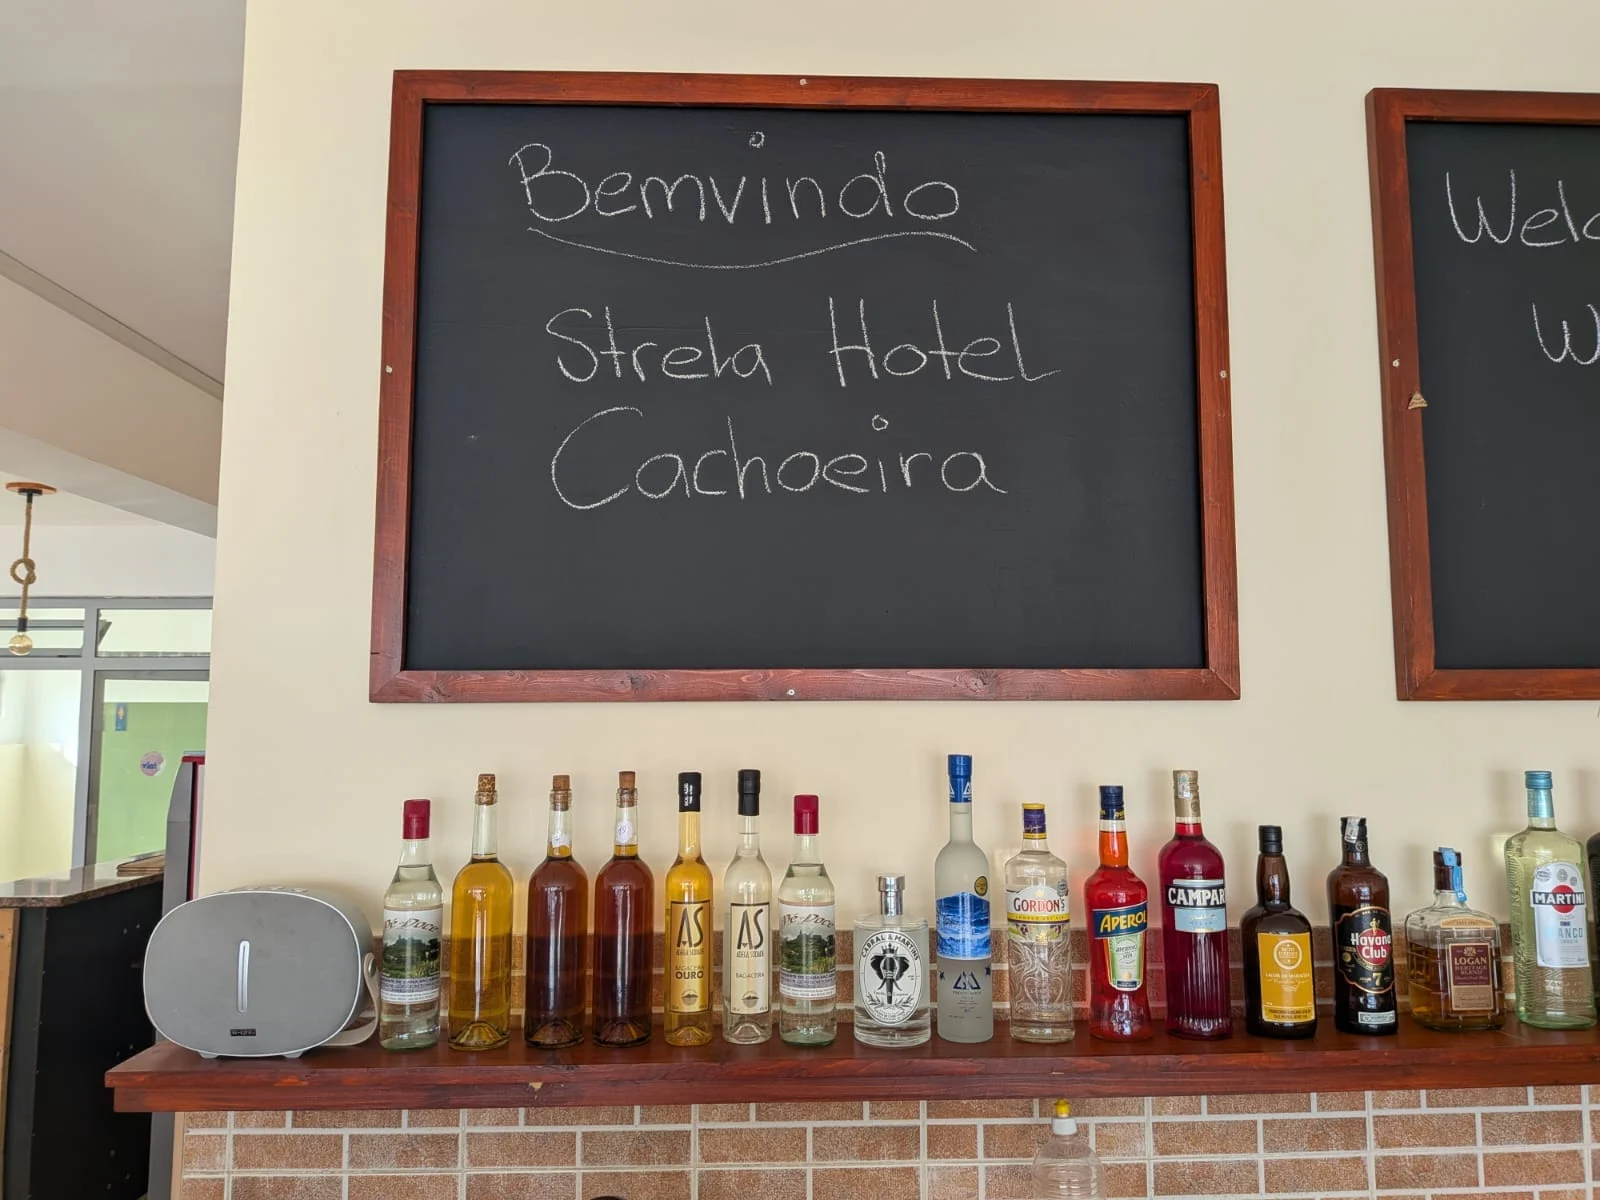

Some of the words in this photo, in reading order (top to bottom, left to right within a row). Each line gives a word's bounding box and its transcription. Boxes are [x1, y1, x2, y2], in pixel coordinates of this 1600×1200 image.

[508, 130, 961, 223] Bemvindo
[828, 296, 1062, 388] Hotel
[550, 405, 1008, 511] Cachoeira
[1013, 897, 1065, 912] GORDON'S
[1534, 893, 1584, 905] MARTINI
[677, 906, 704, 948] AS
[737, 908, 764, 950] AS
[1100, 910, 1147, 933] APEROL
[862, 934, 886, 958] CABRAL
[887, 933, 893, 941] &
[895, 934, 920, 960] MARTINS
[1350, 932, 1391, 946] Havana
[1362, 946, 1387, 959] Club
[1454, 956, 1488, 966] LOGAN
[675, 970, 704, 980] OURO
[1372, 972, 1382, 986] 7
